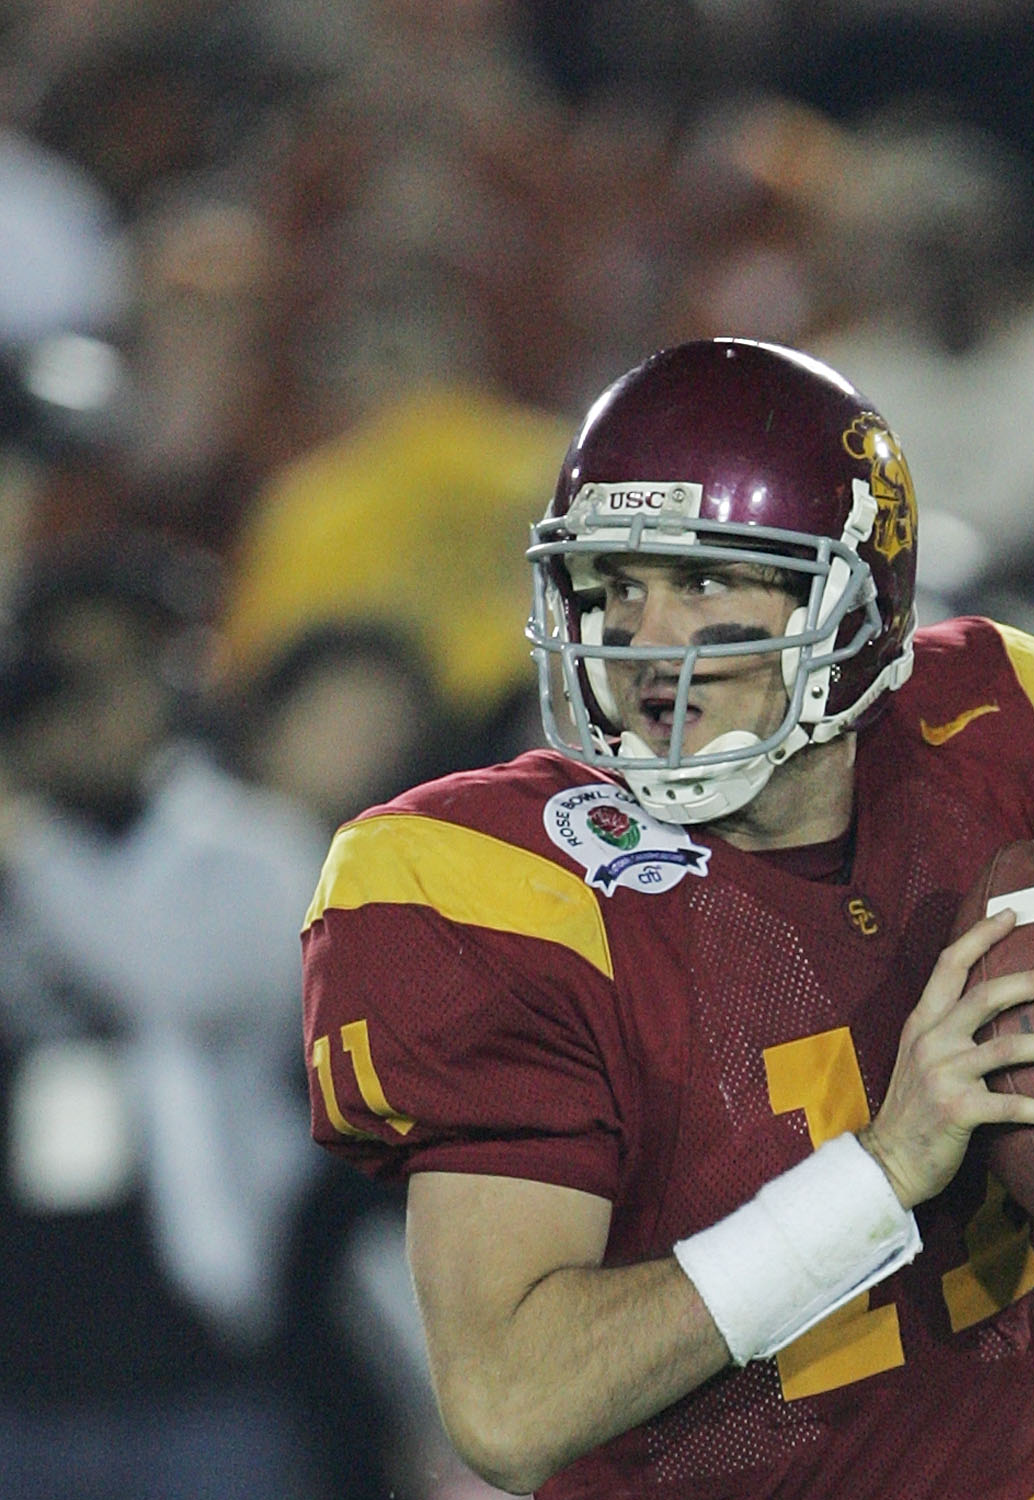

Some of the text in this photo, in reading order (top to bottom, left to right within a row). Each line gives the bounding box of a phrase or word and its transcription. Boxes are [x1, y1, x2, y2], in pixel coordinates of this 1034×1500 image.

[609, 491, 665, 510] USC
[560, 791, 610, 810] BOWL
[556, 810, 583, 848] ROSE
[312, 1018, 417, 1141] 11
